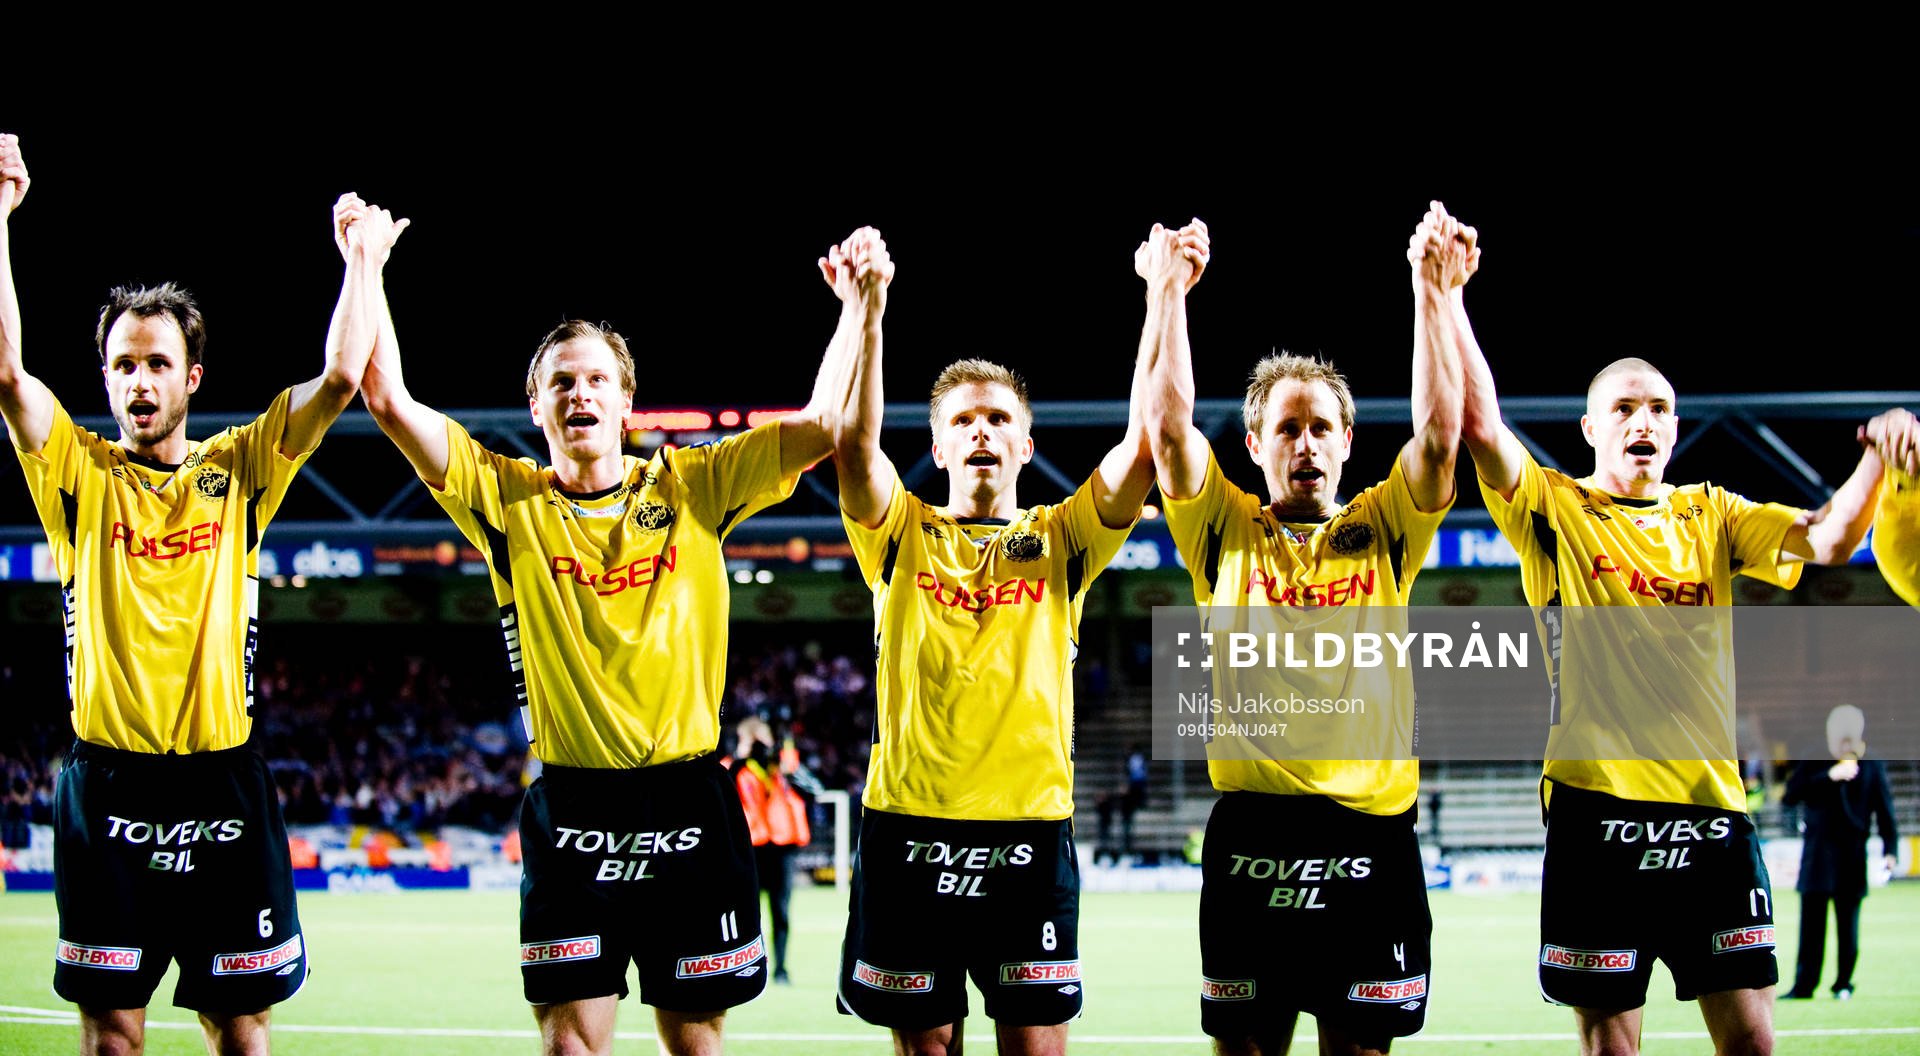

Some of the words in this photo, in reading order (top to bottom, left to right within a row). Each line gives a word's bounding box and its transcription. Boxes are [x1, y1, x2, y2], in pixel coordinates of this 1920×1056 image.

[110, 521, 222, 560] PULSEN
[917, 572, 1045, 613] PULSEN
[1245, 569, 1375, 612] PULSEN
[107, 816, 245, 846] TOVEKS
[556, 827, 702, 854] TOVEKS
[1601, 817, 1731, 843] TOVEKS
[148, 850, 195, 873] BIL
[906, 841, 1033, 869] TOVEKS
[1230, 854, 1373, 881] TOVEKS
[1638, 847, 1692, 870] BIL
[595, 859, 655, 882] BIL
[937, 872, 988, 897] BIL
[1268, 887, 1327, 909] BIL
[258, 908, 273, 938] 6
[721, 910, 738, 942] 11
[1042, 921, 1057, 951] 8
[60, 944, 135, 966] ÄST-BYGG
[521, 941, 595, 961] ÄST-BYGG
[1393, 942, 1406, 972] 4
